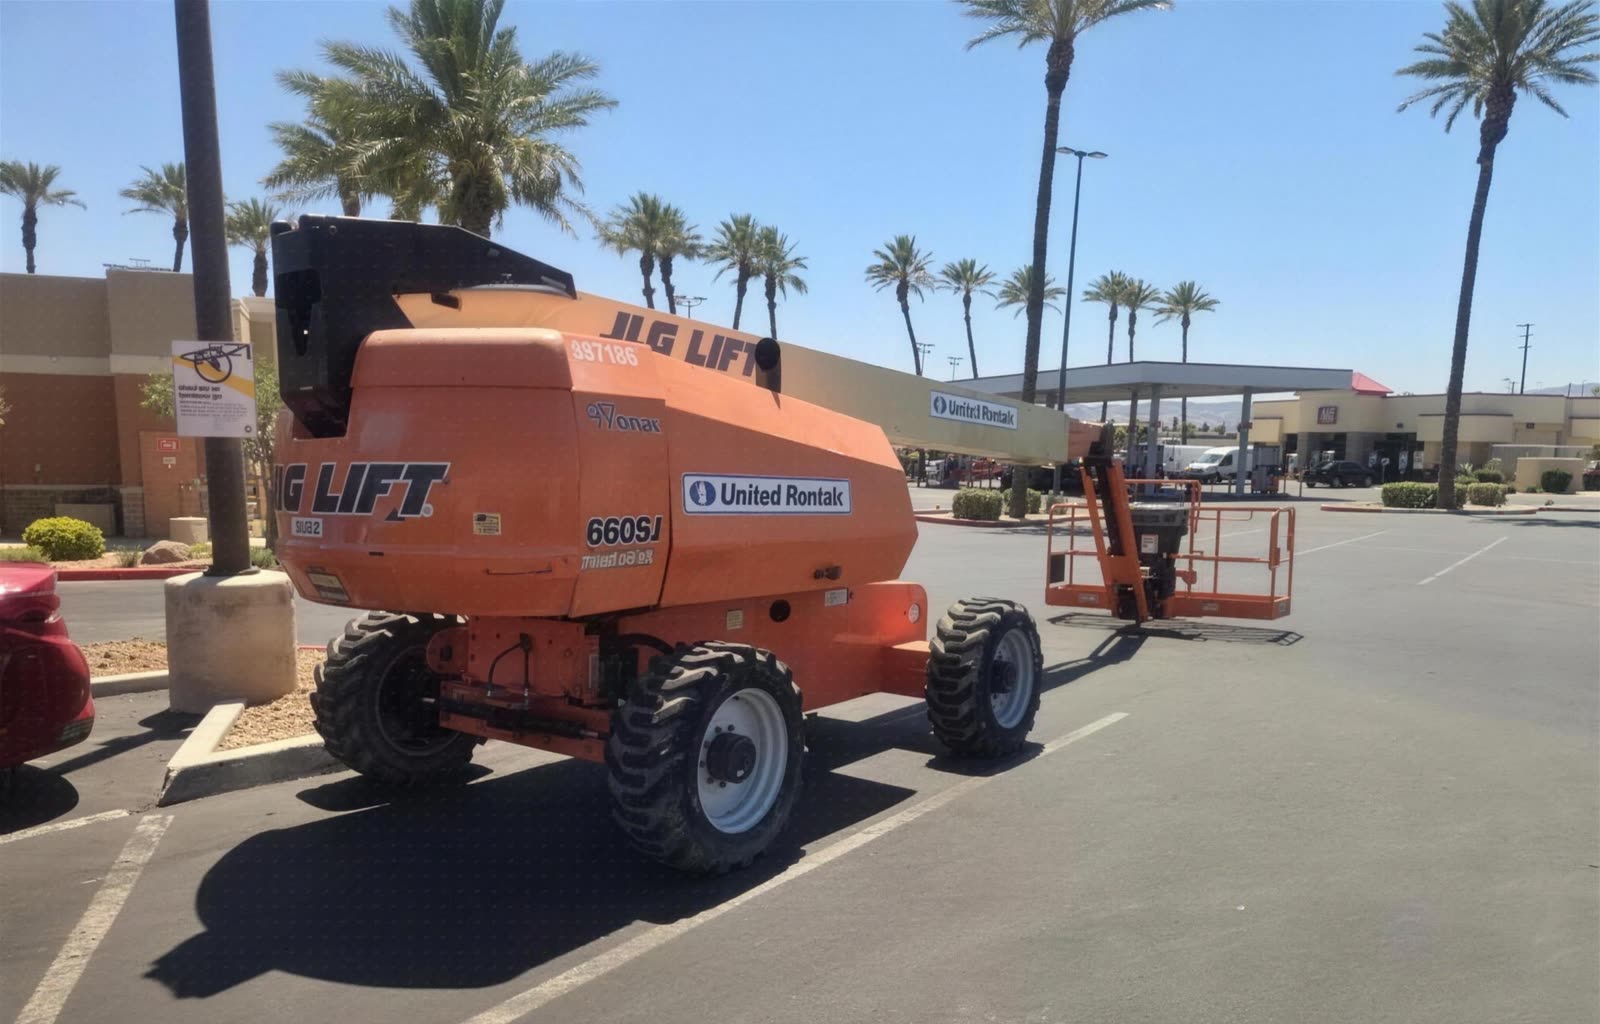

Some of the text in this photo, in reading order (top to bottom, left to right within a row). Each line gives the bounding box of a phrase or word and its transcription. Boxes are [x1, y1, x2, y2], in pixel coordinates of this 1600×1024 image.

[599, 310, 758, 378] JLG LIFT
[312, 462, 450, 517] LIFT
[720, 483, 781, 506] United
